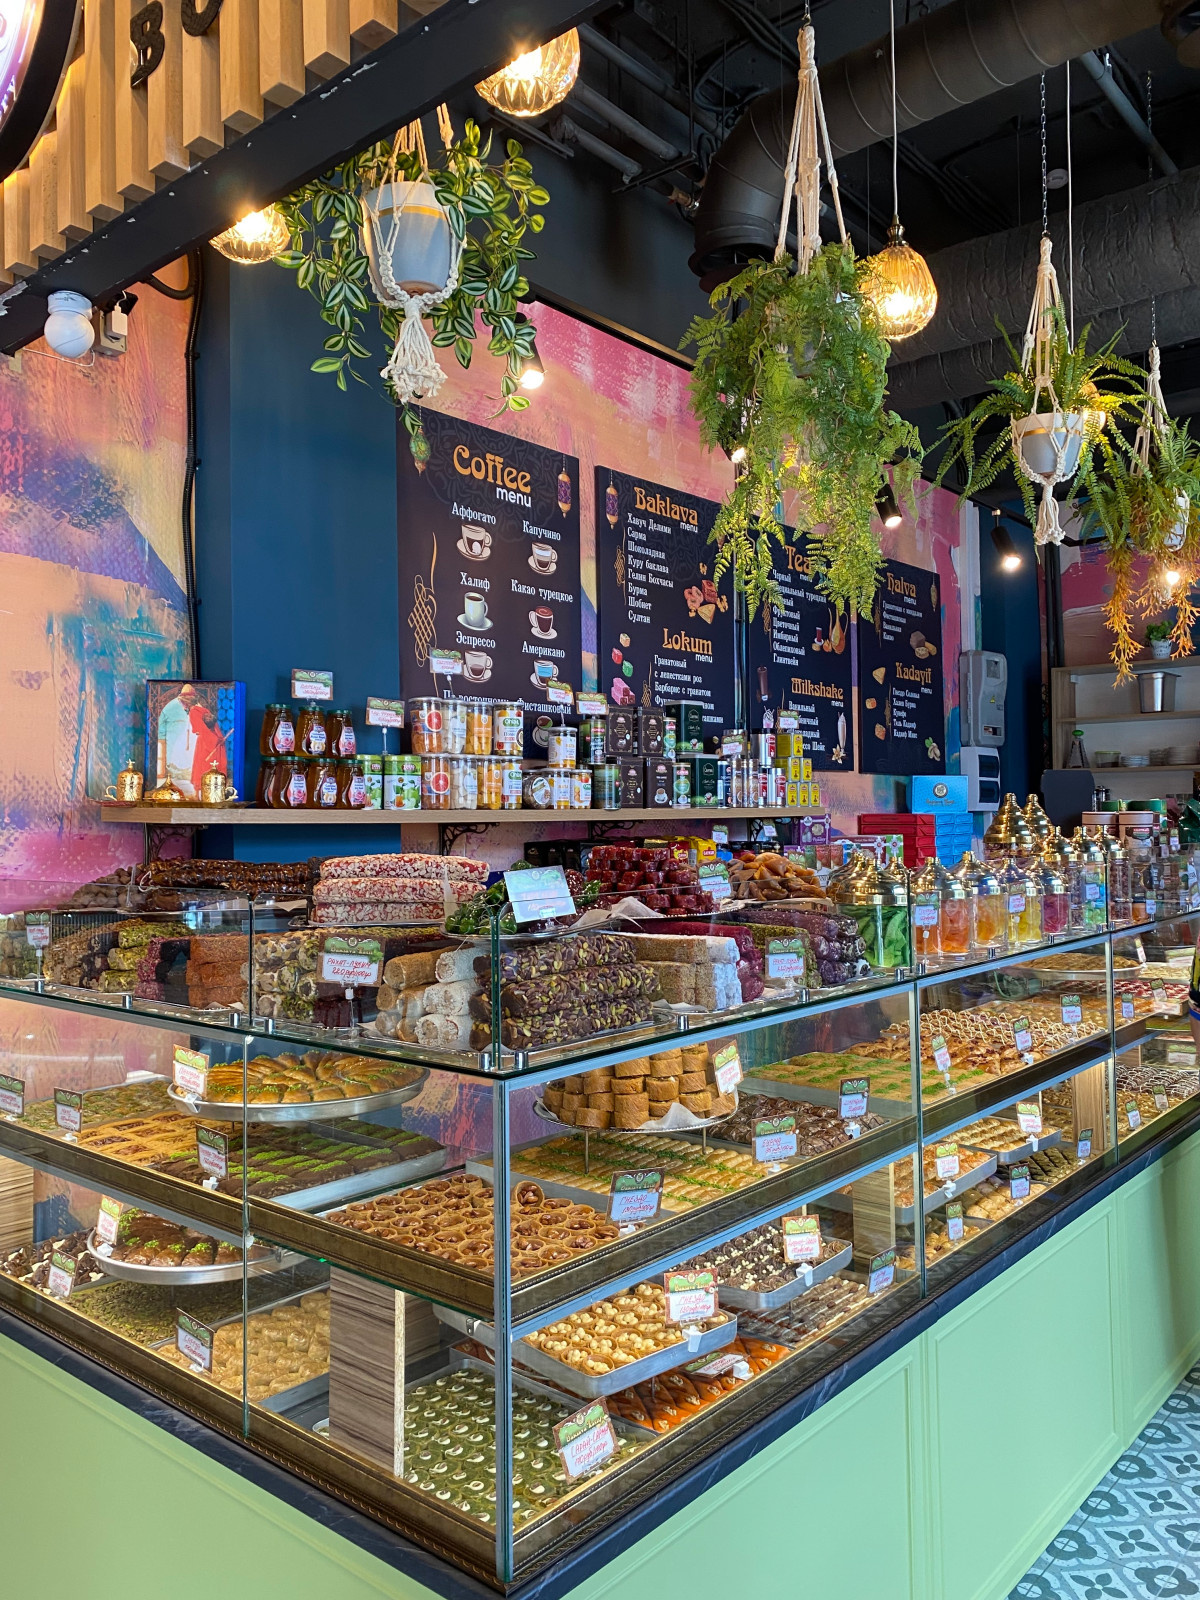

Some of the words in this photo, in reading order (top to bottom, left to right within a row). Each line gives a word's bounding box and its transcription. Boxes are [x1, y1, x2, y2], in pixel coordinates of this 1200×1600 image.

[453, 445, 531, 493] Coffee
[496, 487, 532, 508] menu
[634, 486, 698, 525] Baklava
[452, 502, 496, 525] Аффогато
[523, 520, 561, 541] Капучино
[627, 527, 647, 541] Сарма
[680, 521, 698, 533] menu
[628, 540, 666, 559] Шоколадная
[628, 554, 644, 570] Куру
[645, 559, 669, 574] баклава
[785, 545, 812, 574] Tea
[460, 572, 490, 592] Халиф
[511, 579, 536, 595] Какао
[538, 588, 573, 603] турецкое
[628, 582, 648, 596] Бурма
[628, 609, 651, 623] Султан
[456, 631, 496, 649] Эспрессо
[522, 641, 565, 658] Американо
[662, 627, 713, 655] Lokum
[654, 654, 687, 669] Гранатовый
[695, 653, 713, 663] menu
[660, 671, 691, 682] лепестками
[654, 681, 681, 696] Барбарис
